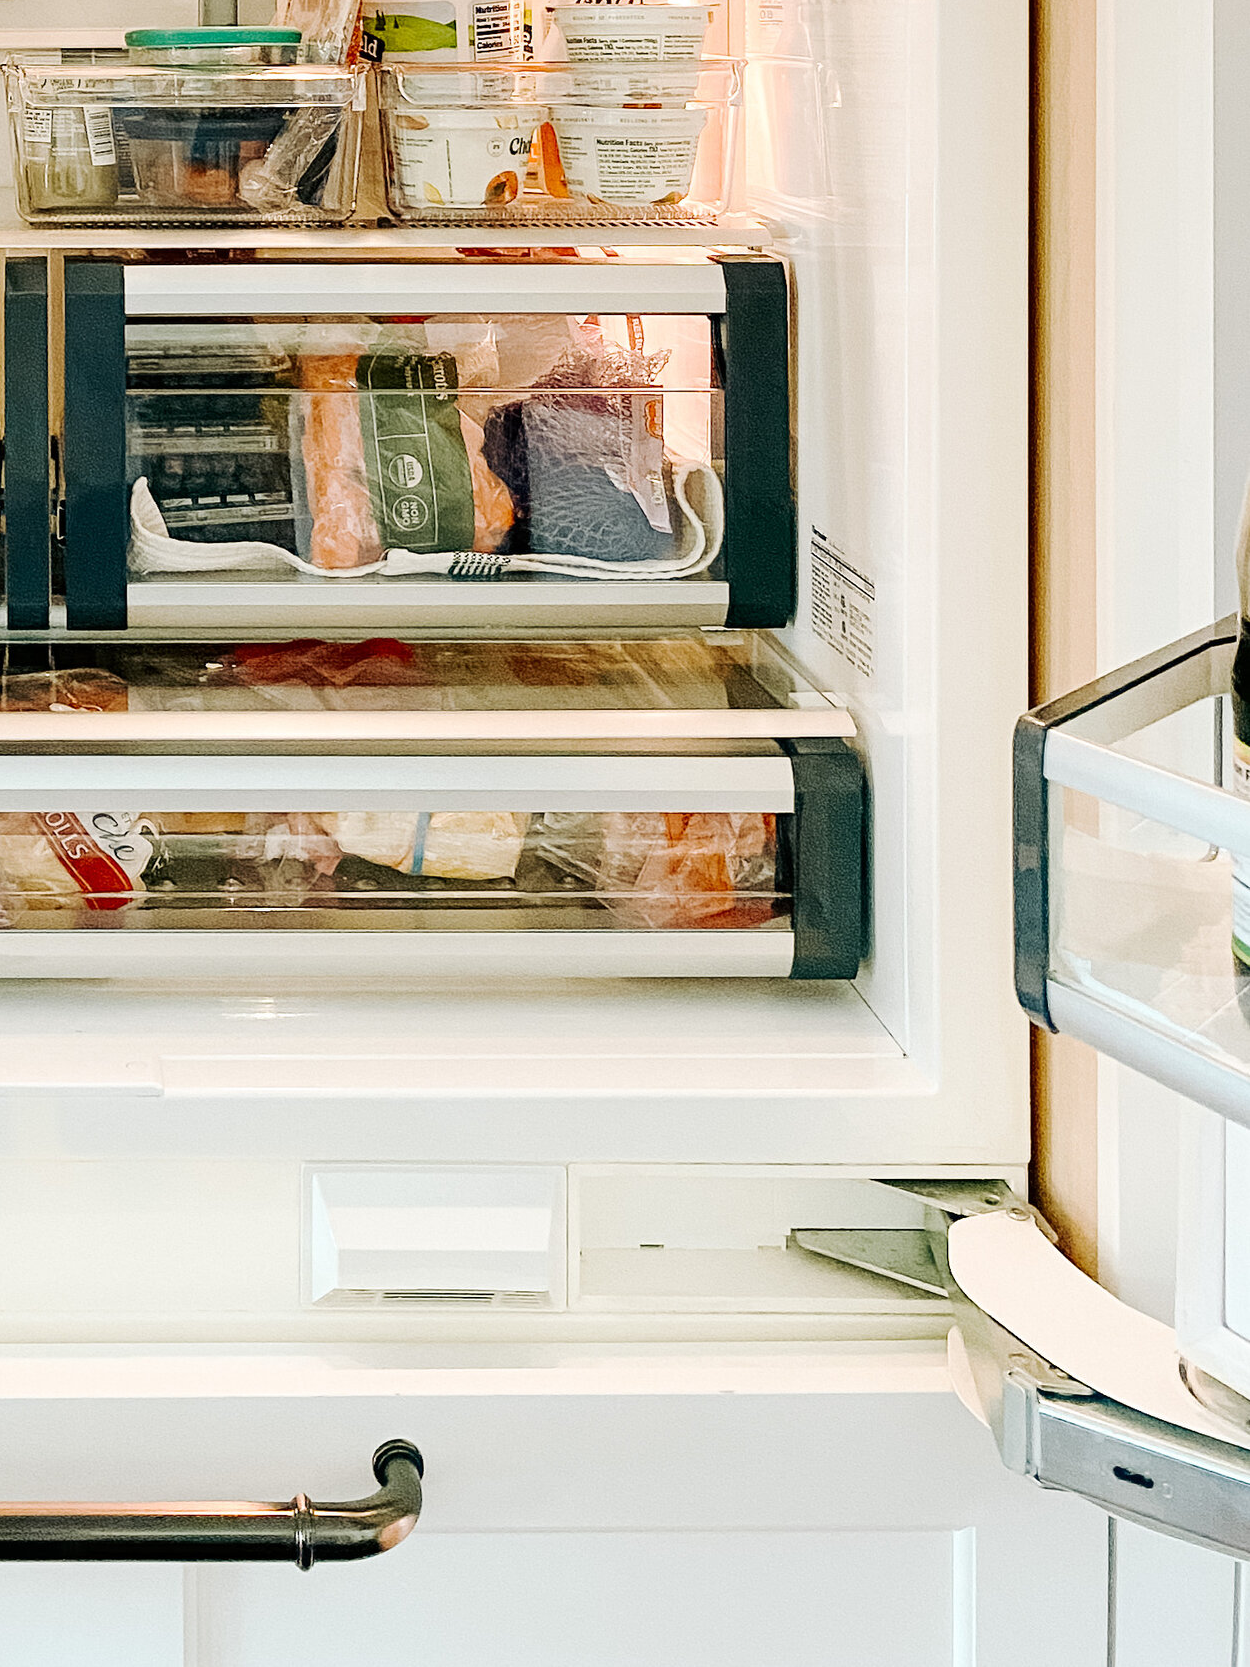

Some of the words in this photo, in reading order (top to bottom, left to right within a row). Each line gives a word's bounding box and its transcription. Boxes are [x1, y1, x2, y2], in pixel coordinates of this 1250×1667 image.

[475, 4, 508, 14] Nutrition
[625, 139, 643, 147] Facts
[400, 501, 411, 526] GMO
[410, 501, 421, 525] NON
